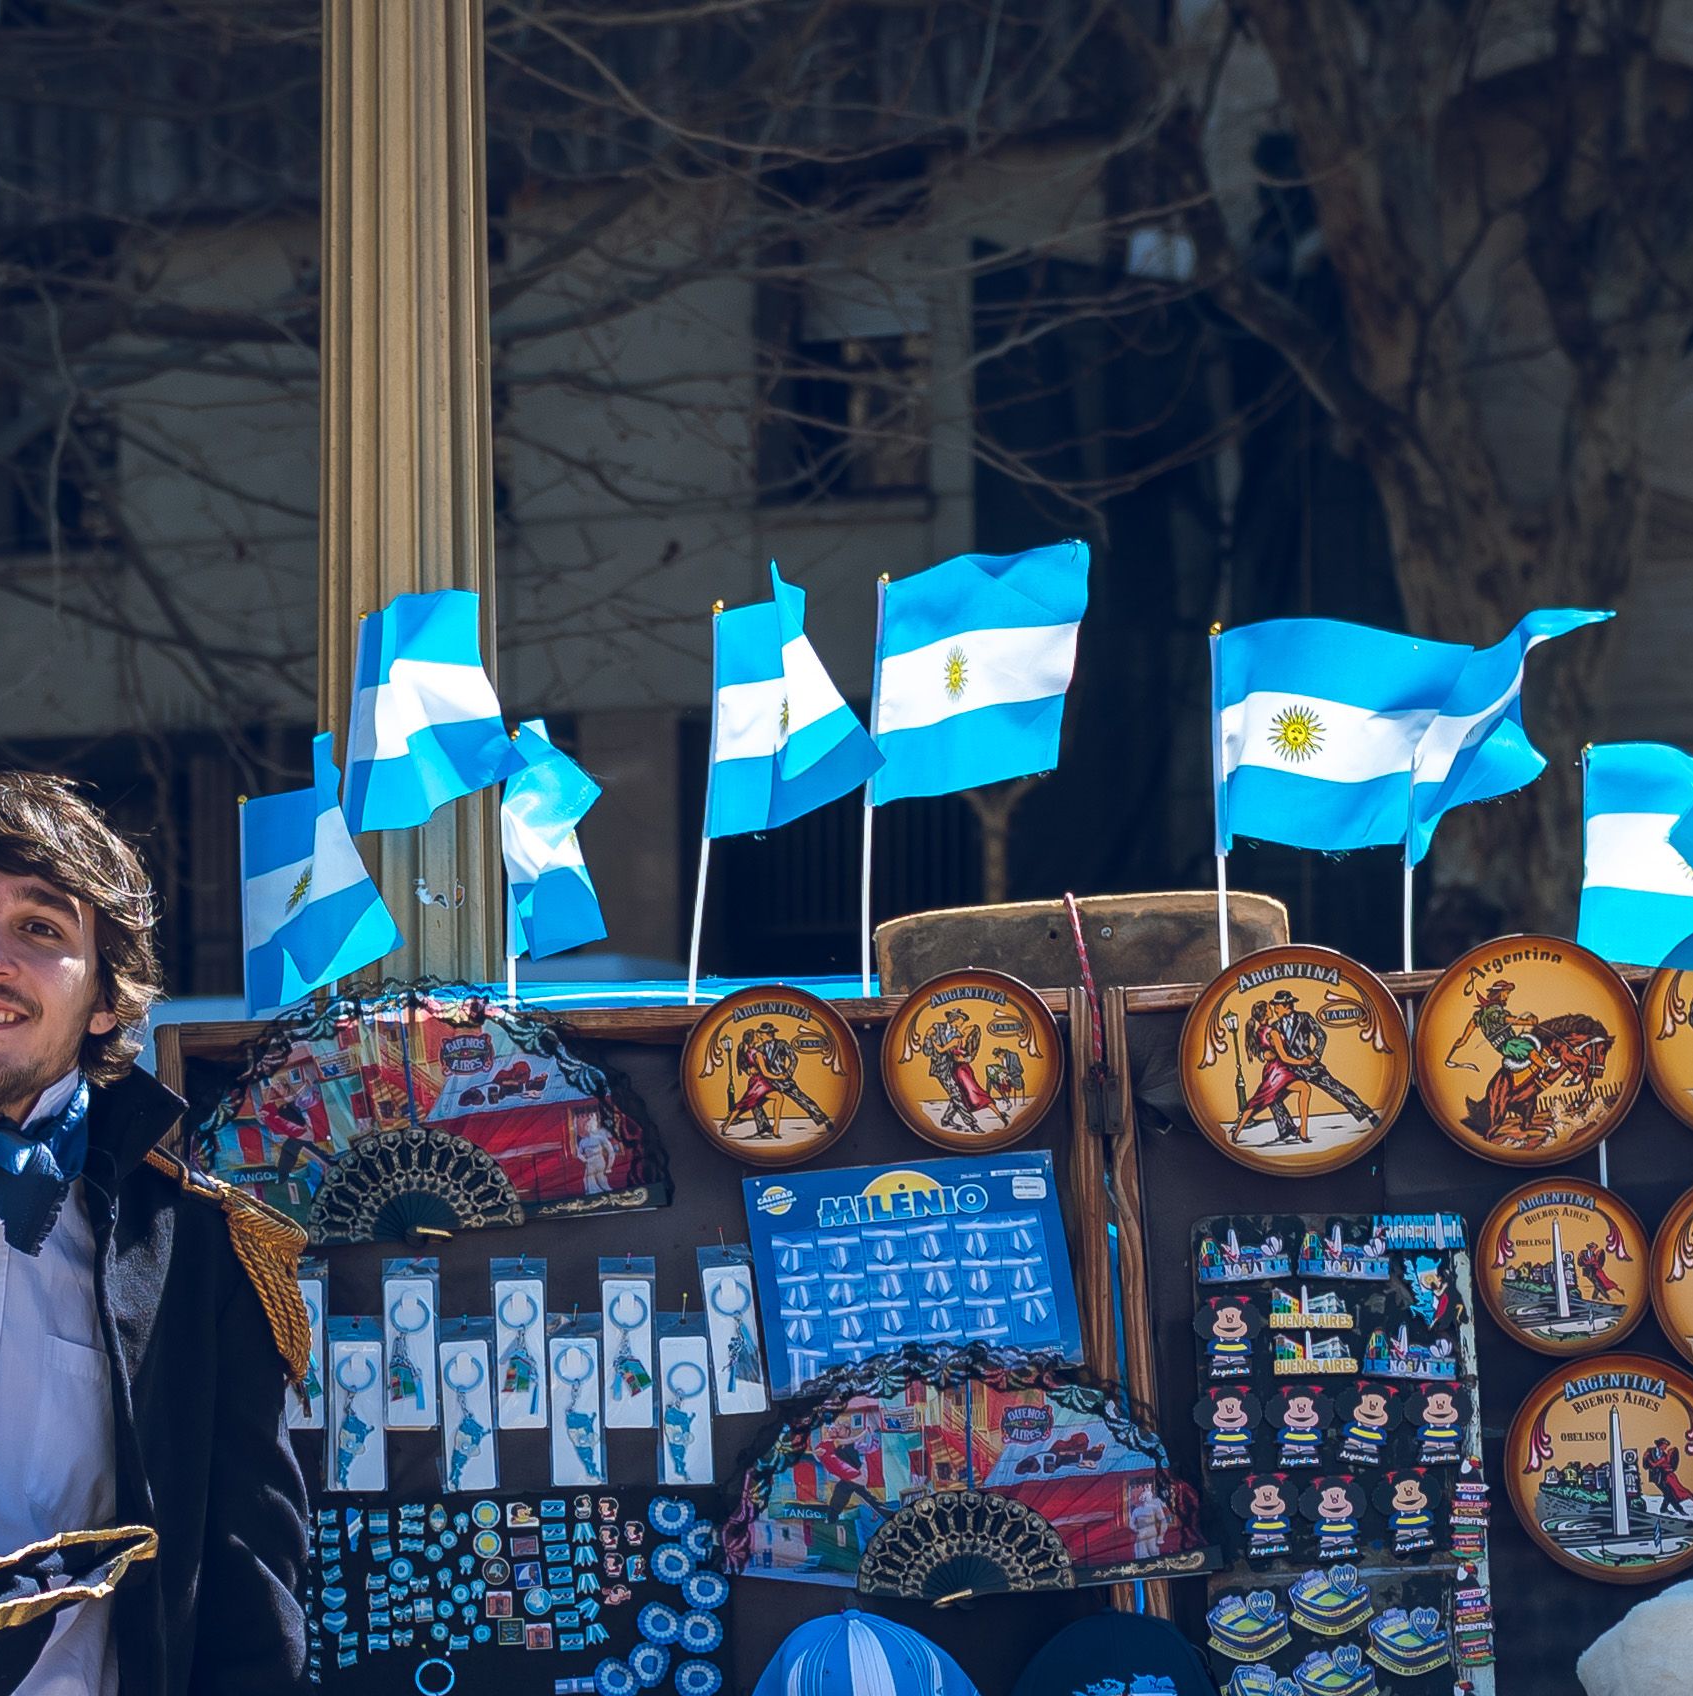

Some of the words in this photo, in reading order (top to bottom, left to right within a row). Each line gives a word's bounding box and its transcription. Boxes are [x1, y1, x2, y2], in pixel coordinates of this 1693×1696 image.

[1238, 963, 1340, 993] ARGENTINA
[1463, 947, 1562, 996] Argentina
[930, 986, 1007, 1009] ARGENTINA
[733, 1001, 811, 1022] ARGENTINA
[1324, 1009, 1360, 1020] TANGO
[447, 1038, 486, 1050] BUENOS
[451, 1058, 483, 1071] AIRES
[234, 1172, 271, 1184] TANGO
[757, 1190, 793, 1205] CALIDAD
[1518, 1191, 1595, 1214] ARGENTINA
[817, 1184, 988, 1228] MILENIO
[1524, 1208, 1559, 1225] BUENOS
[1562, 1207, 1590, 1222] AIRES
[1270, 1314, 1316, 1327] BUENOS
[1318, 1314, 1353, 1327] AIRES
[1211, 1367, 1250, 1377] Argentina
[1274, 1360, 1320, 1374] BUENOS
[1322, 1359, 1358, 1373] AIRES
[1564, 1373, 1667, 1401] ARGENTINA
[1571, 1393, 1619, 1414] BUENOS
[1623, 1392, 1661, 1412] AIRES
[1007, 1407, 1046, 1421] BUENOS
[1011, 1428, 1042, 1441] AIRES
[1560, 1431, 1607, 1441] OBELISCO
[1212, 1457, 1251, 1467] Argentina
[1280, 1456, 1319, 1466] Argentina
[1339, 1450, 1379, 1464] Argentina
[1420, 1454, 1460, 1464] Argentina
[783, 1508, 821, 1519] TANGO
[1250, 1545, 1290, 1556] Argentina
[1395, 1539, 1435, 1552] Argentina
[1319, 1547, 1359, 1559] Argentina
